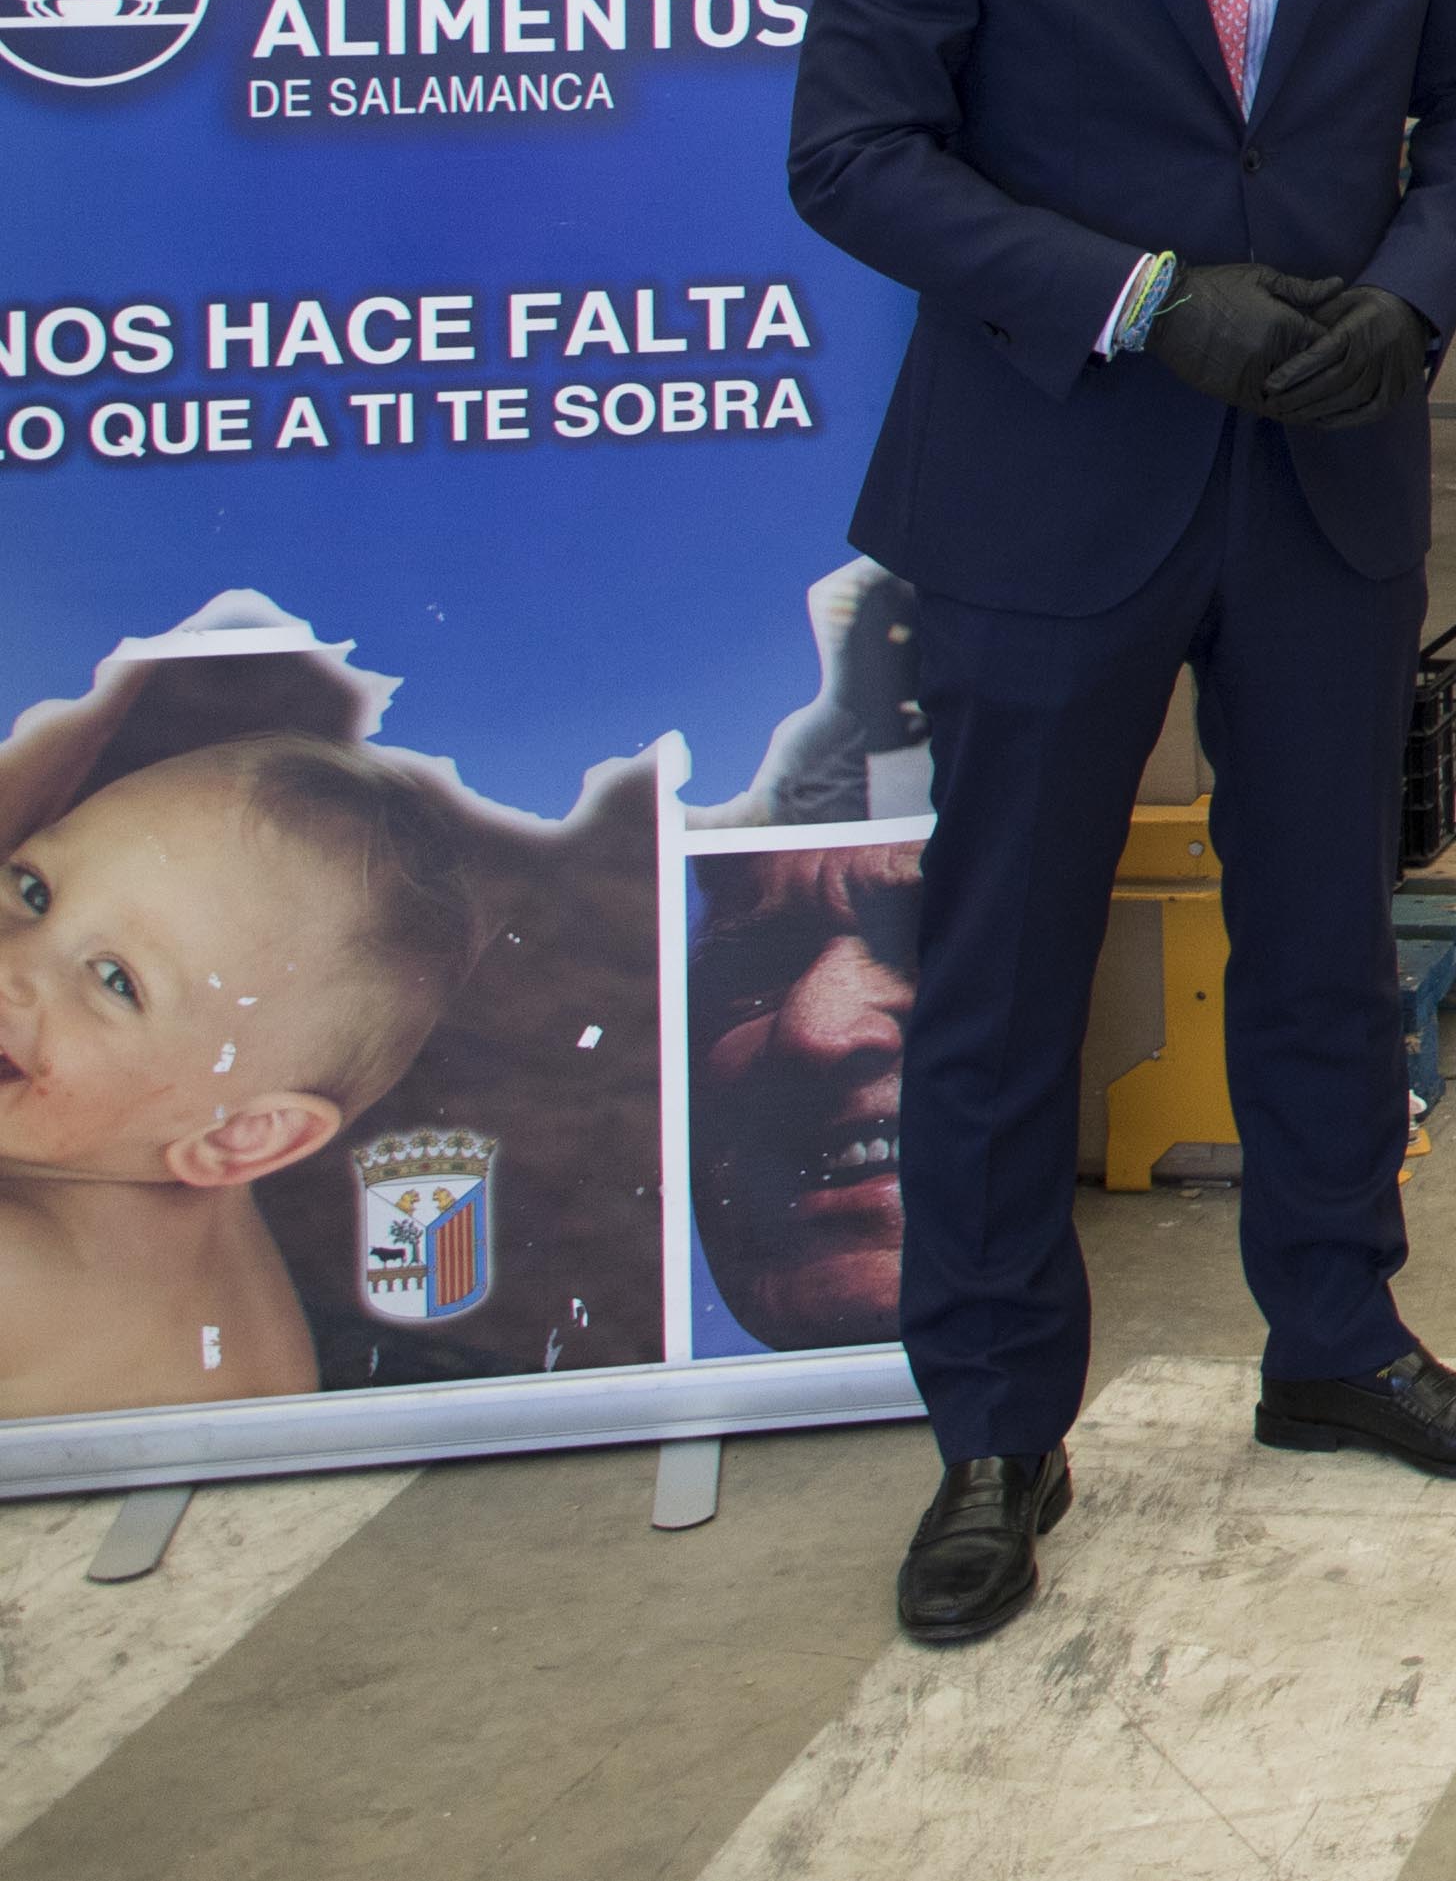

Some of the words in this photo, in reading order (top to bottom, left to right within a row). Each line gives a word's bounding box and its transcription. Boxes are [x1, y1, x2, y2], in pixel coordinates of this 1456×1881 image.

[249, 79, 312, 118] DE
[329, 72, 615, 117] SALAMANCA
[207, 294, 476, 371] HACE
[509, 283, 811, 360] FALTA
[0, 405, 66, 463] O
[90, 397, 252, 460] QUE
[276, 395, 329, 450] A
[351, 391, 415, 446] TI
[437, 386, 530, 444] TE
[553, 377, 813, 439] SOBRA
